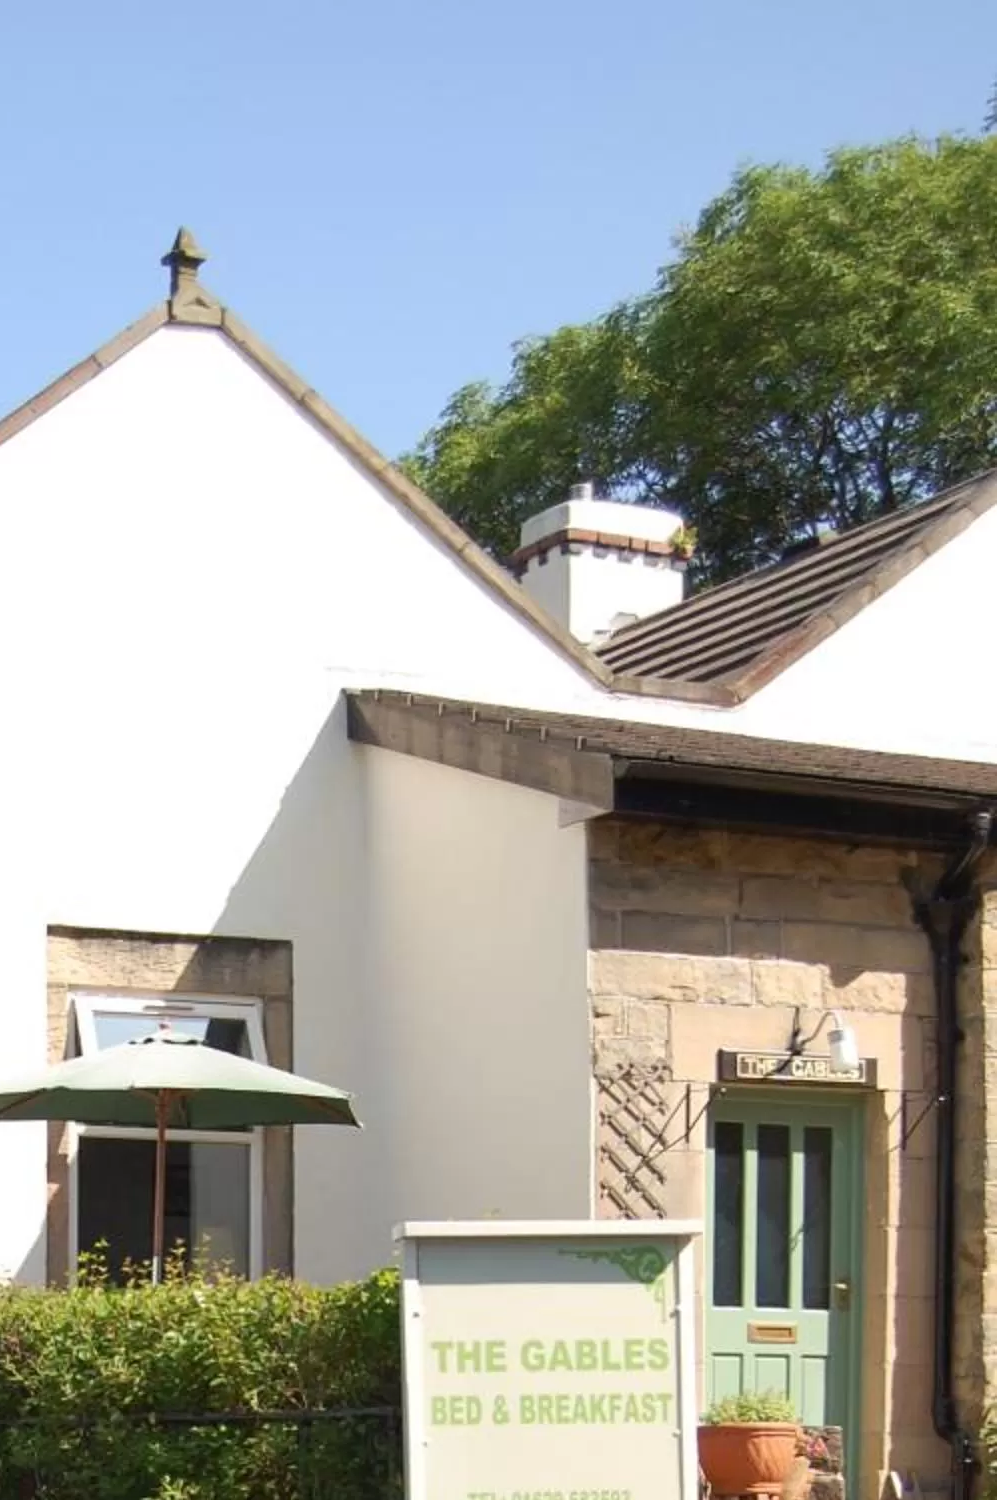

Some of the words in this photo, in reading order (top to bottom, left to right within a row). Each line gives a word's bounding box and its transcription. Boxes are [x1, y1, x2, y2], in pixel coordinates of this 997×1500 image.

[741, 1058, 778, 1078] THE
[430, 1341, 508, 1374] THE
[520, 1338, 671, 1372] GABLES
[431, 1396, 482, 1426] BED
[492, 1396, 511, 1425] &
[519, 1393, 673, 1425] BREAKFAST
